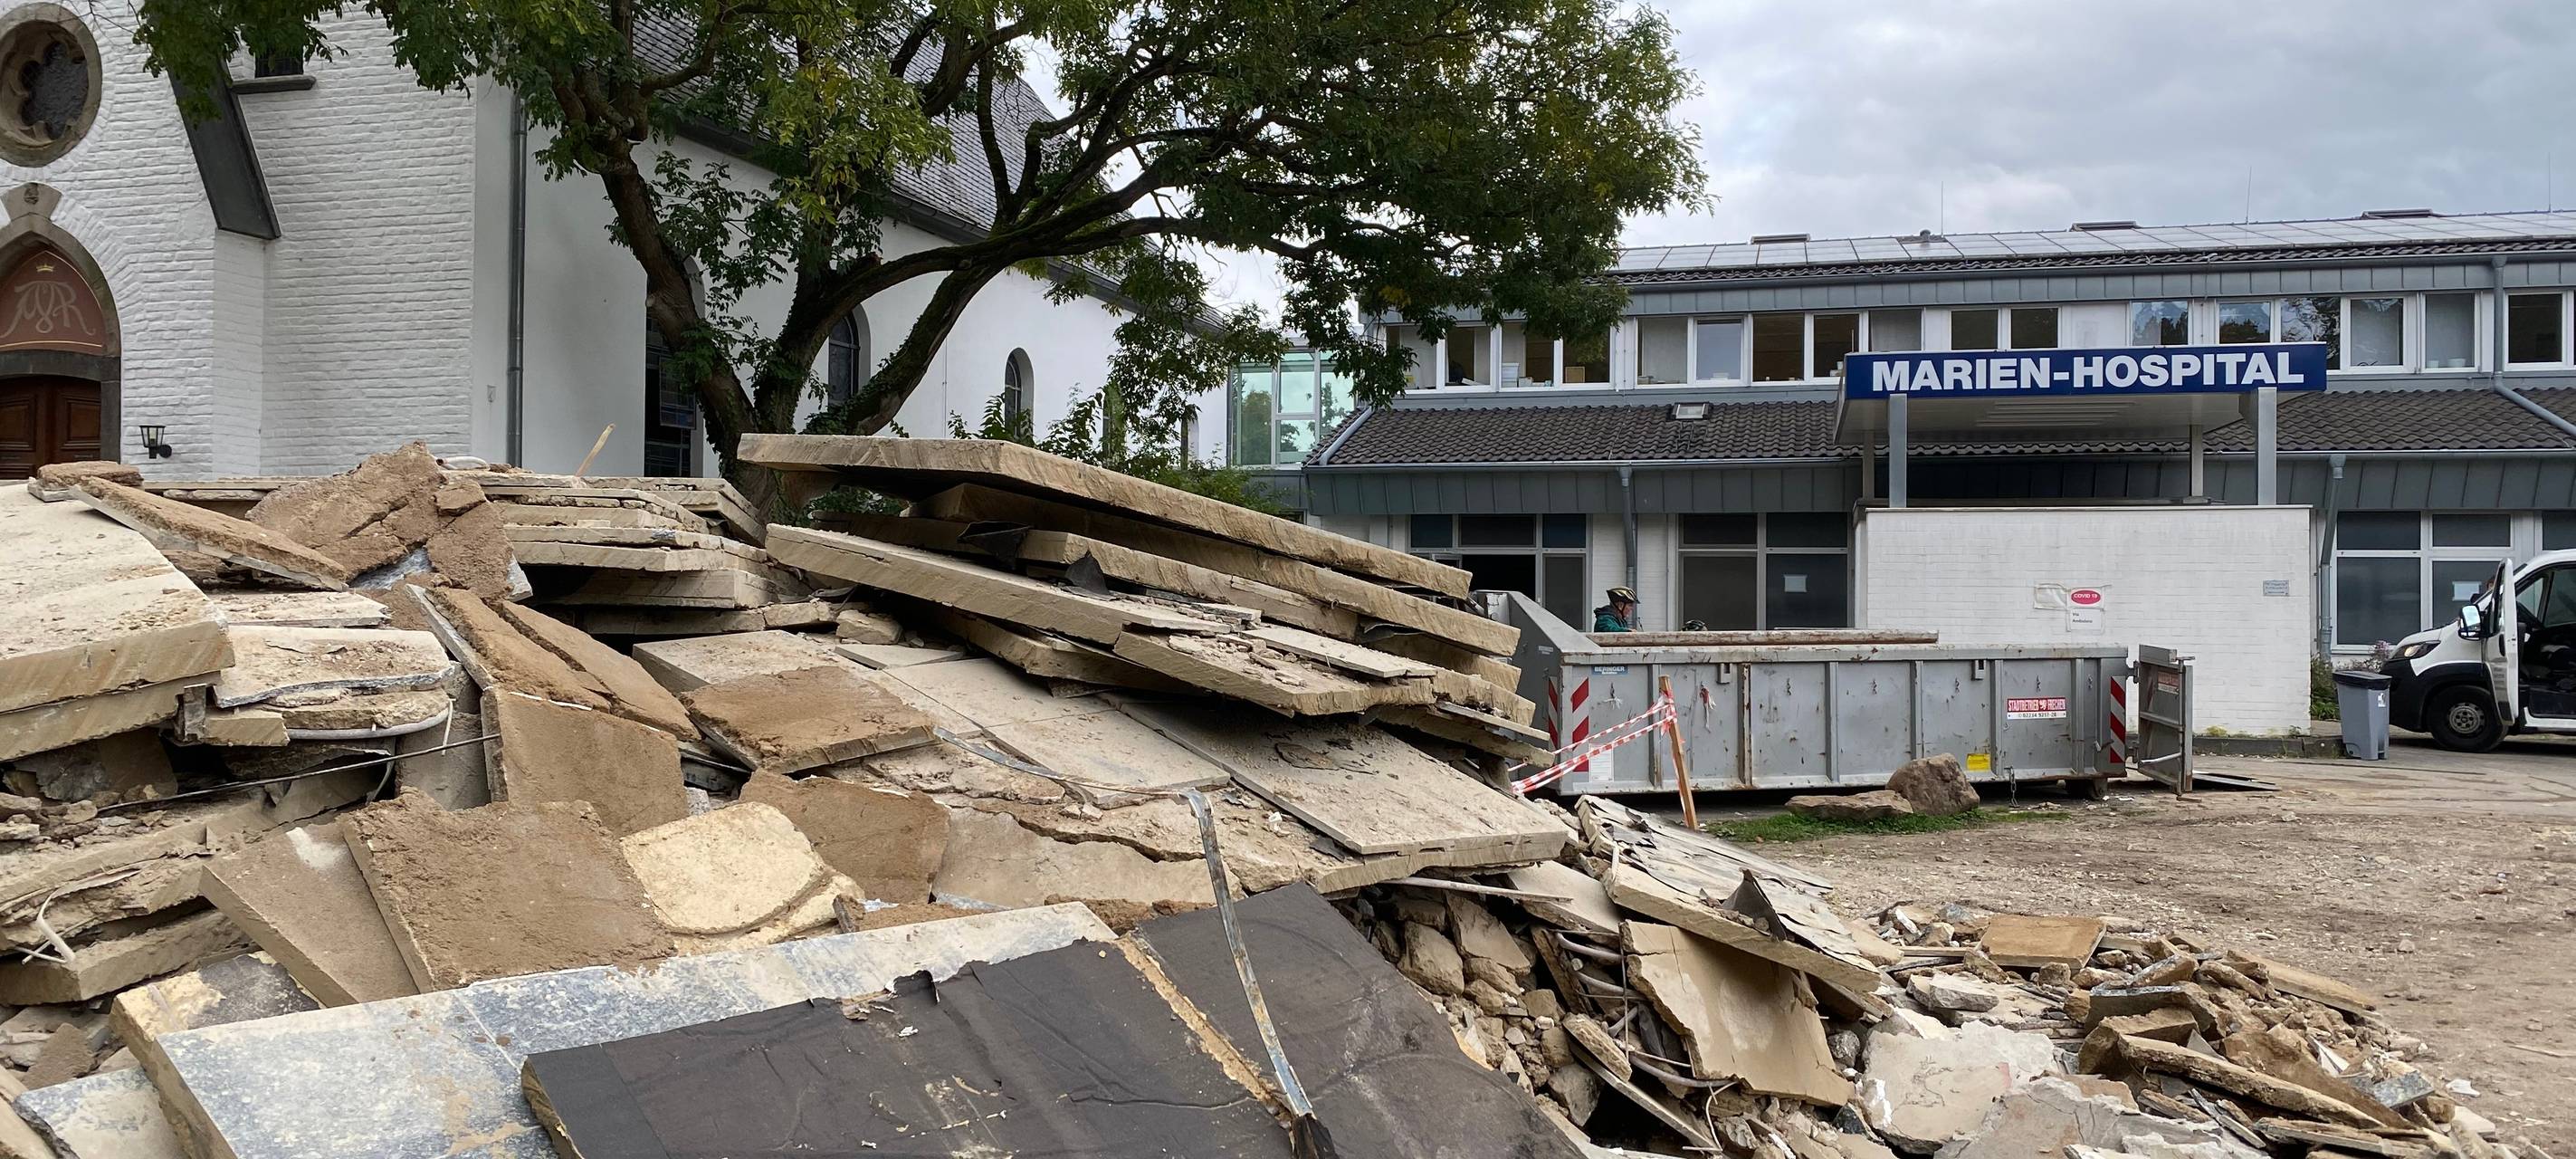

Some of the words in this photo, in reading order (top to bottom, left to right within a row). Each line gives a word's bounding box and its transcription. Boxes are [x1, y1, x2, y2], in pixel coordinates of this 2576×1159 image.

[1872, 351, 2304, 392] MARIEN-HOSPITAL
[2008, 699, 2038, 711] STADTBETRIEB
[2047, 699, 2066, 710] FRECHEN
